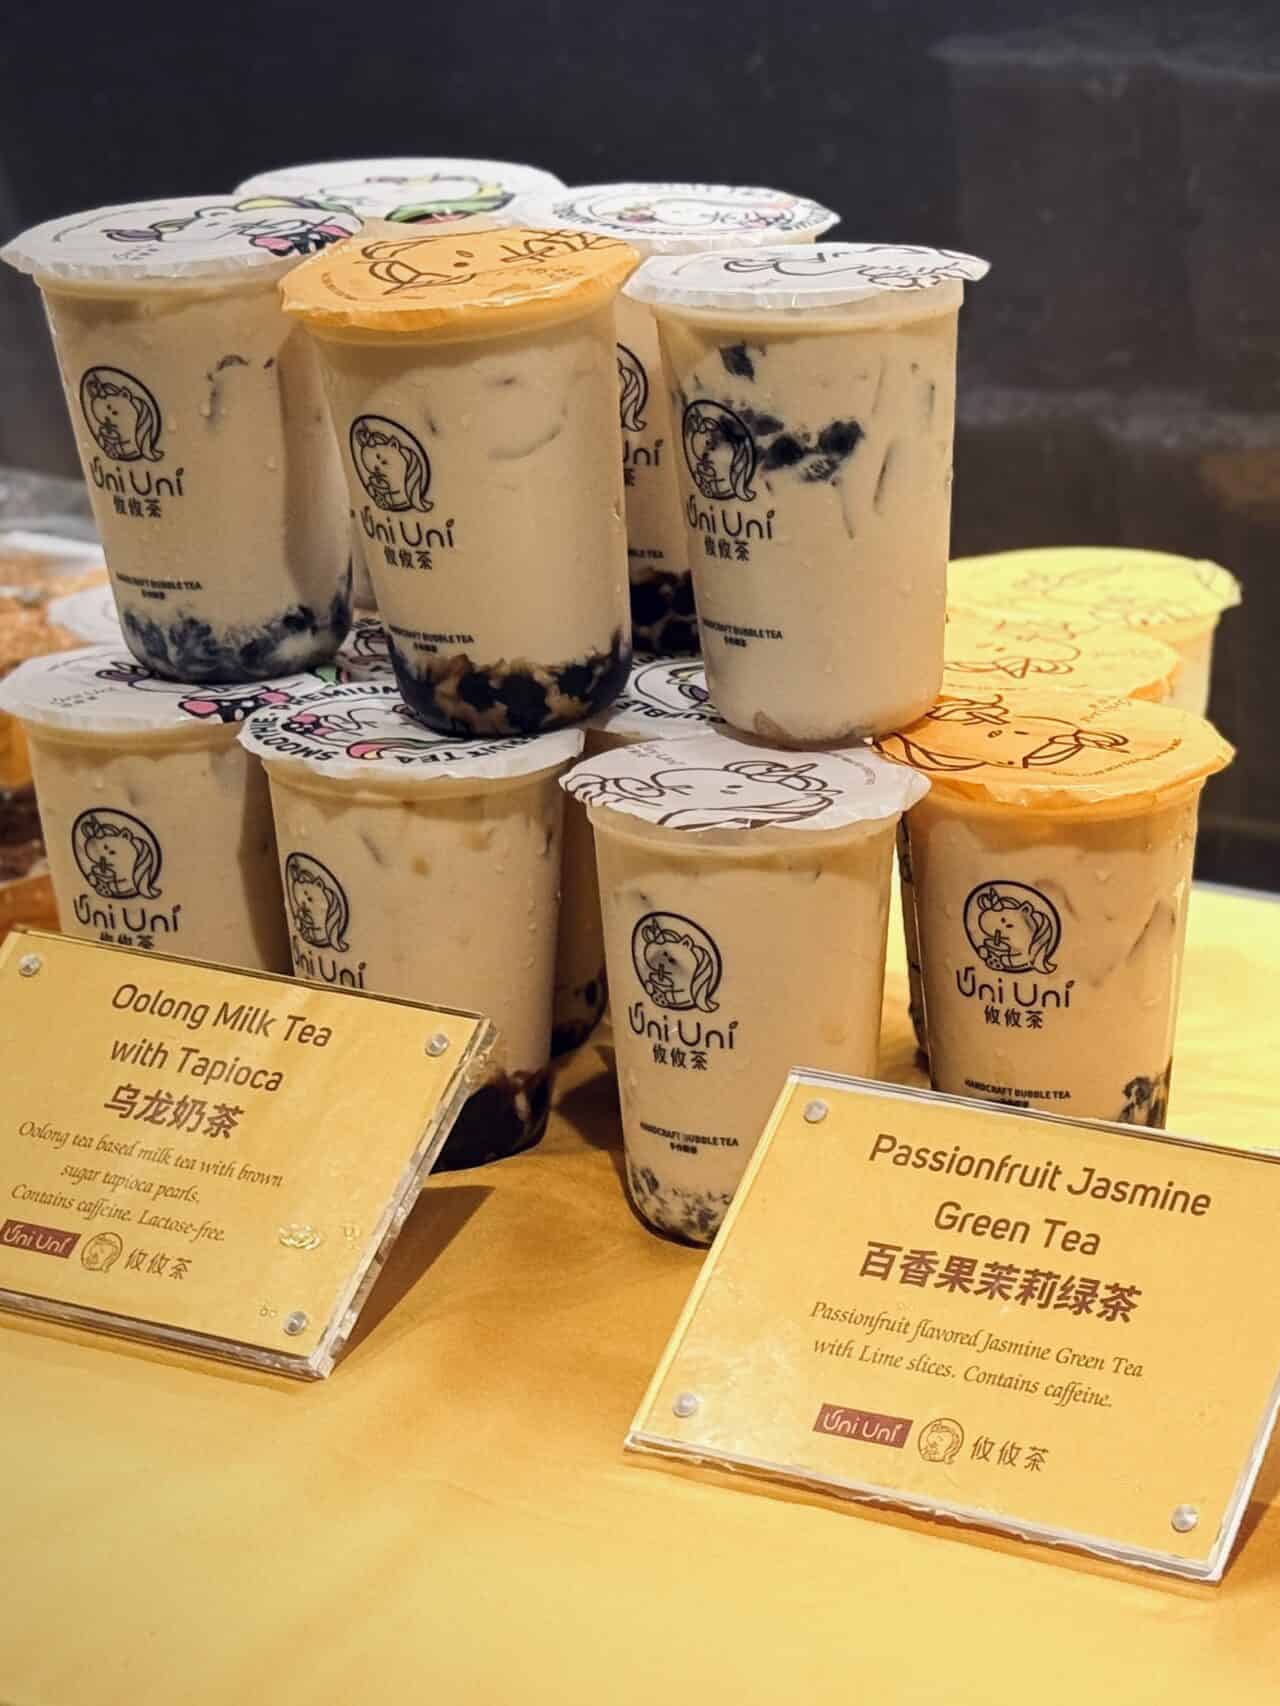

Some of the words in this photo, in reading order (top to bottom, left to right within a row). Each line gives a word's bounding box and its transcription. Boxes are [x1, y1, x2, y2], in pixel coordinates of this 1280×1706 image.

[90, 456, 125, 493] Uni
[129, 467, 185, 496] Uni
[360, 506, 396, 545] Uni
[400, 518, 455, 548] Uni
[687, 494, 716, 534] Uni
[722, 510, 775, 540] Uni
[766, 630, 783, 640] TEA
[395, 752, 464, 764] TEA
[73, 894, 115, 930] Uni
[124, 904, 182, 933] Uni
[319, 954, 366, 989] Uni
[956, 966, 1003, 1004] Uni
[1013, 980, 1076, 1009] Uni
[111, 984, 210, 1030] Oolong
[212, 1002, 278, 1037] Milk
[283, 1015, 332, 1047] Tea
[628, 1002, 670, 1042] Uni
[678, 1020, 739, 1049] Uni
[111, 1038, 169, 1069] with
[177, 1047, 284, 1091] Tapioca
[104, 1083, 245, 1139] 乌龙奶茶
[1014, 1089, 1051, 1099] BUBBLE
[1053, 1090, 1072, 1100] TEA
[19, 1121, 70, 1150] Oolong
[72, 1133, 92, 1148] tea
[96, 1134, 135, 1157] based
[137, 1146, 170, 1167] milk
[175, 1154, 195, 1170] tea
[200, 1158, 234, 1177] with
[238, 1163, 284, 1188] brown
[720, 1137, 739, 1147] TEA
[60, 1165, 101, 1186] sugar
[102, 1170, 152, 1195] tapioca
[152, 1180, 200, 1204] pearls.
[868, 1133, 1062, 1192] Passionfruit
[1066, 1167, 1212, 1217] Jasmine
[11, 1184, 74, 1210] Contains
[77, 1198, 131, 1222] caffeine.
[138, 1209, 225, 1243] Lactose-free.
[934, 1201, 1031, 1244] Green
[1042, 1218, 1101, 1256] Tea
[3, 1223, 33, 1247] Uni
[35, 1232, 72, 1254] Uni
[124, 1248, 193, 1280] 攸攸茶
[859, 1240, 1143, 1323] 百香果茉莉绿茶
[810, 1301, 910, 1335] Passionfruit
[907, 1318, 983, 1347] flavored
[980, 1332, 1050, 1361] Jasmine
[1055, 1347, 1105, 1371] Green
[1112, 1356, 1144, 1378] Tea
[814, 1338, 854, 1360] with
[858, 1345, 904, 1370] Lime
[905, 1354, 956, 1379] slices.
[963, 1365, 1041, 1394] Contains
[1043, 1381, 1112, 1408] caffeine.
[822, 1407, 860, 1434] Uni
[862, 1423, 903, 1444] Uni
[970, 1435, 1049, 1472] 攸攸茶
